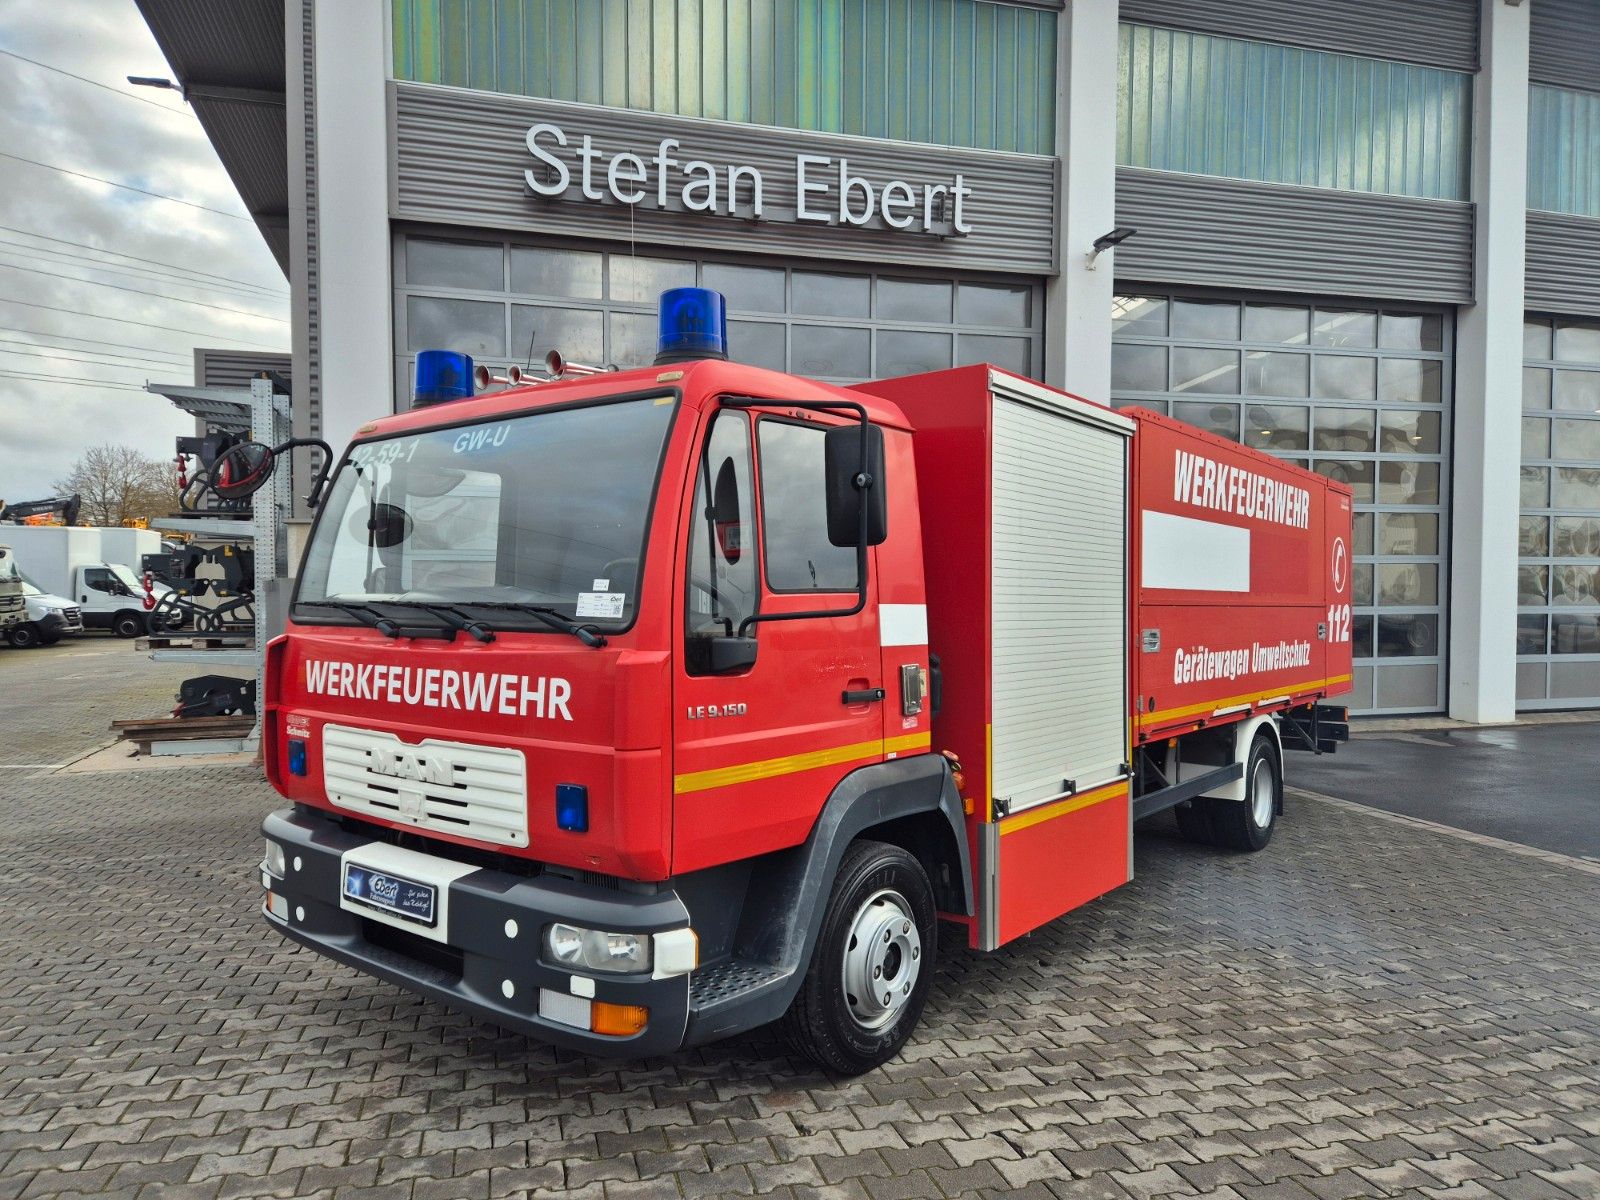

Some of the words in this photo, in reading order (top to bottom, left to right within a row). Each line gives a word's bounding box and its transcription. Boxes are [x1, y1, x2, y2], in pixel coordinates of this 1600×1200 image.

[524, 123, 763, 219] Stefan
[795, 153, 973, 235] Ebert
[453, 424, 511, 453] GW-U
[1174, 449, 1310, 530] WERKFEUERWEHR
[1327, 604, 1350, 643] 112
[1174, 645, 1249, 684] Gerätewagen
[1252, 640, 1311, 674] Umweltschutz
[305, 659, 574, 722] WERKFEUERWEHR
[687, 706, 705, 720] LE
[707, 703, 747, 719] 9.150
[371, 747, 455, 787] MAN
[374, 876, 399, 897] Ebert
